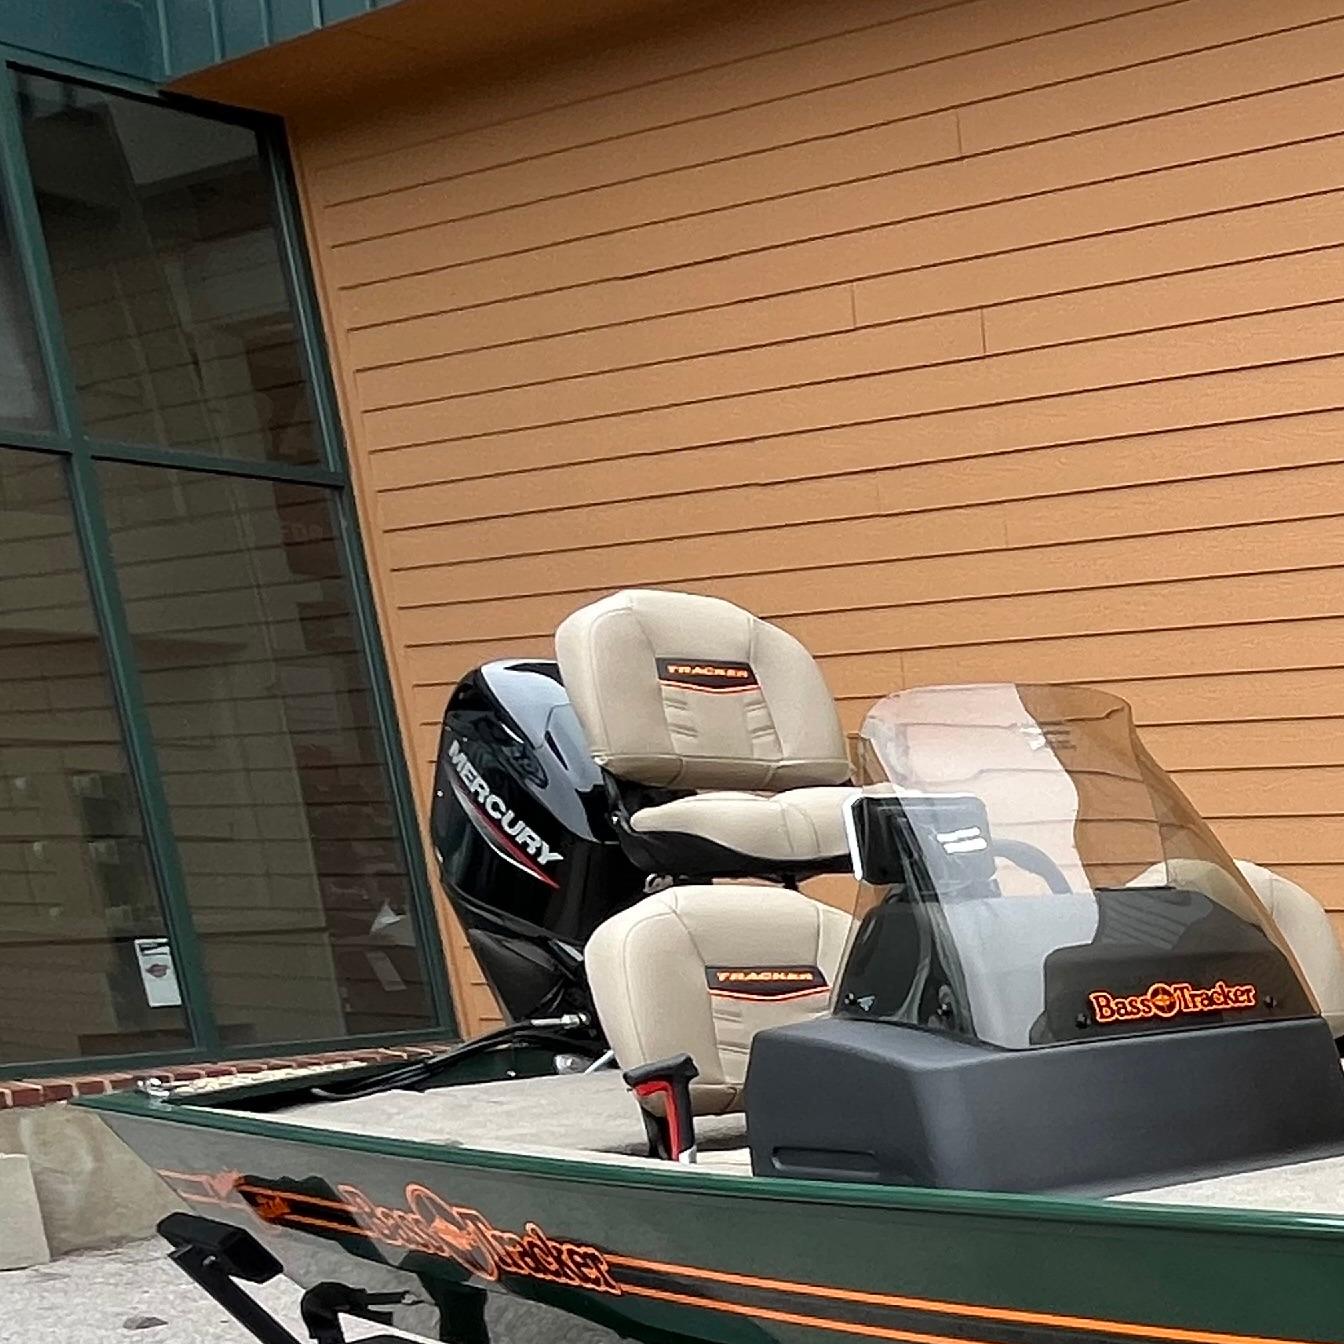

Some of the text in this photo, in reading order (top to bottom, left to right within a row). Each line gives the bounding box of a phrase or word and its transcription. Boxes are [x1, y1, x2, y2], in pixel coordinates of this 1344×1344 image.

[667, 665, 748, 678] TRACKER
[449, 740, 564, 865] MERCURY
[717, 972, 813, 982] TRACKER
[1089, 982, 1256, 1022] Bass Tracker
[450, 1206, 622, 1295] Tracker
